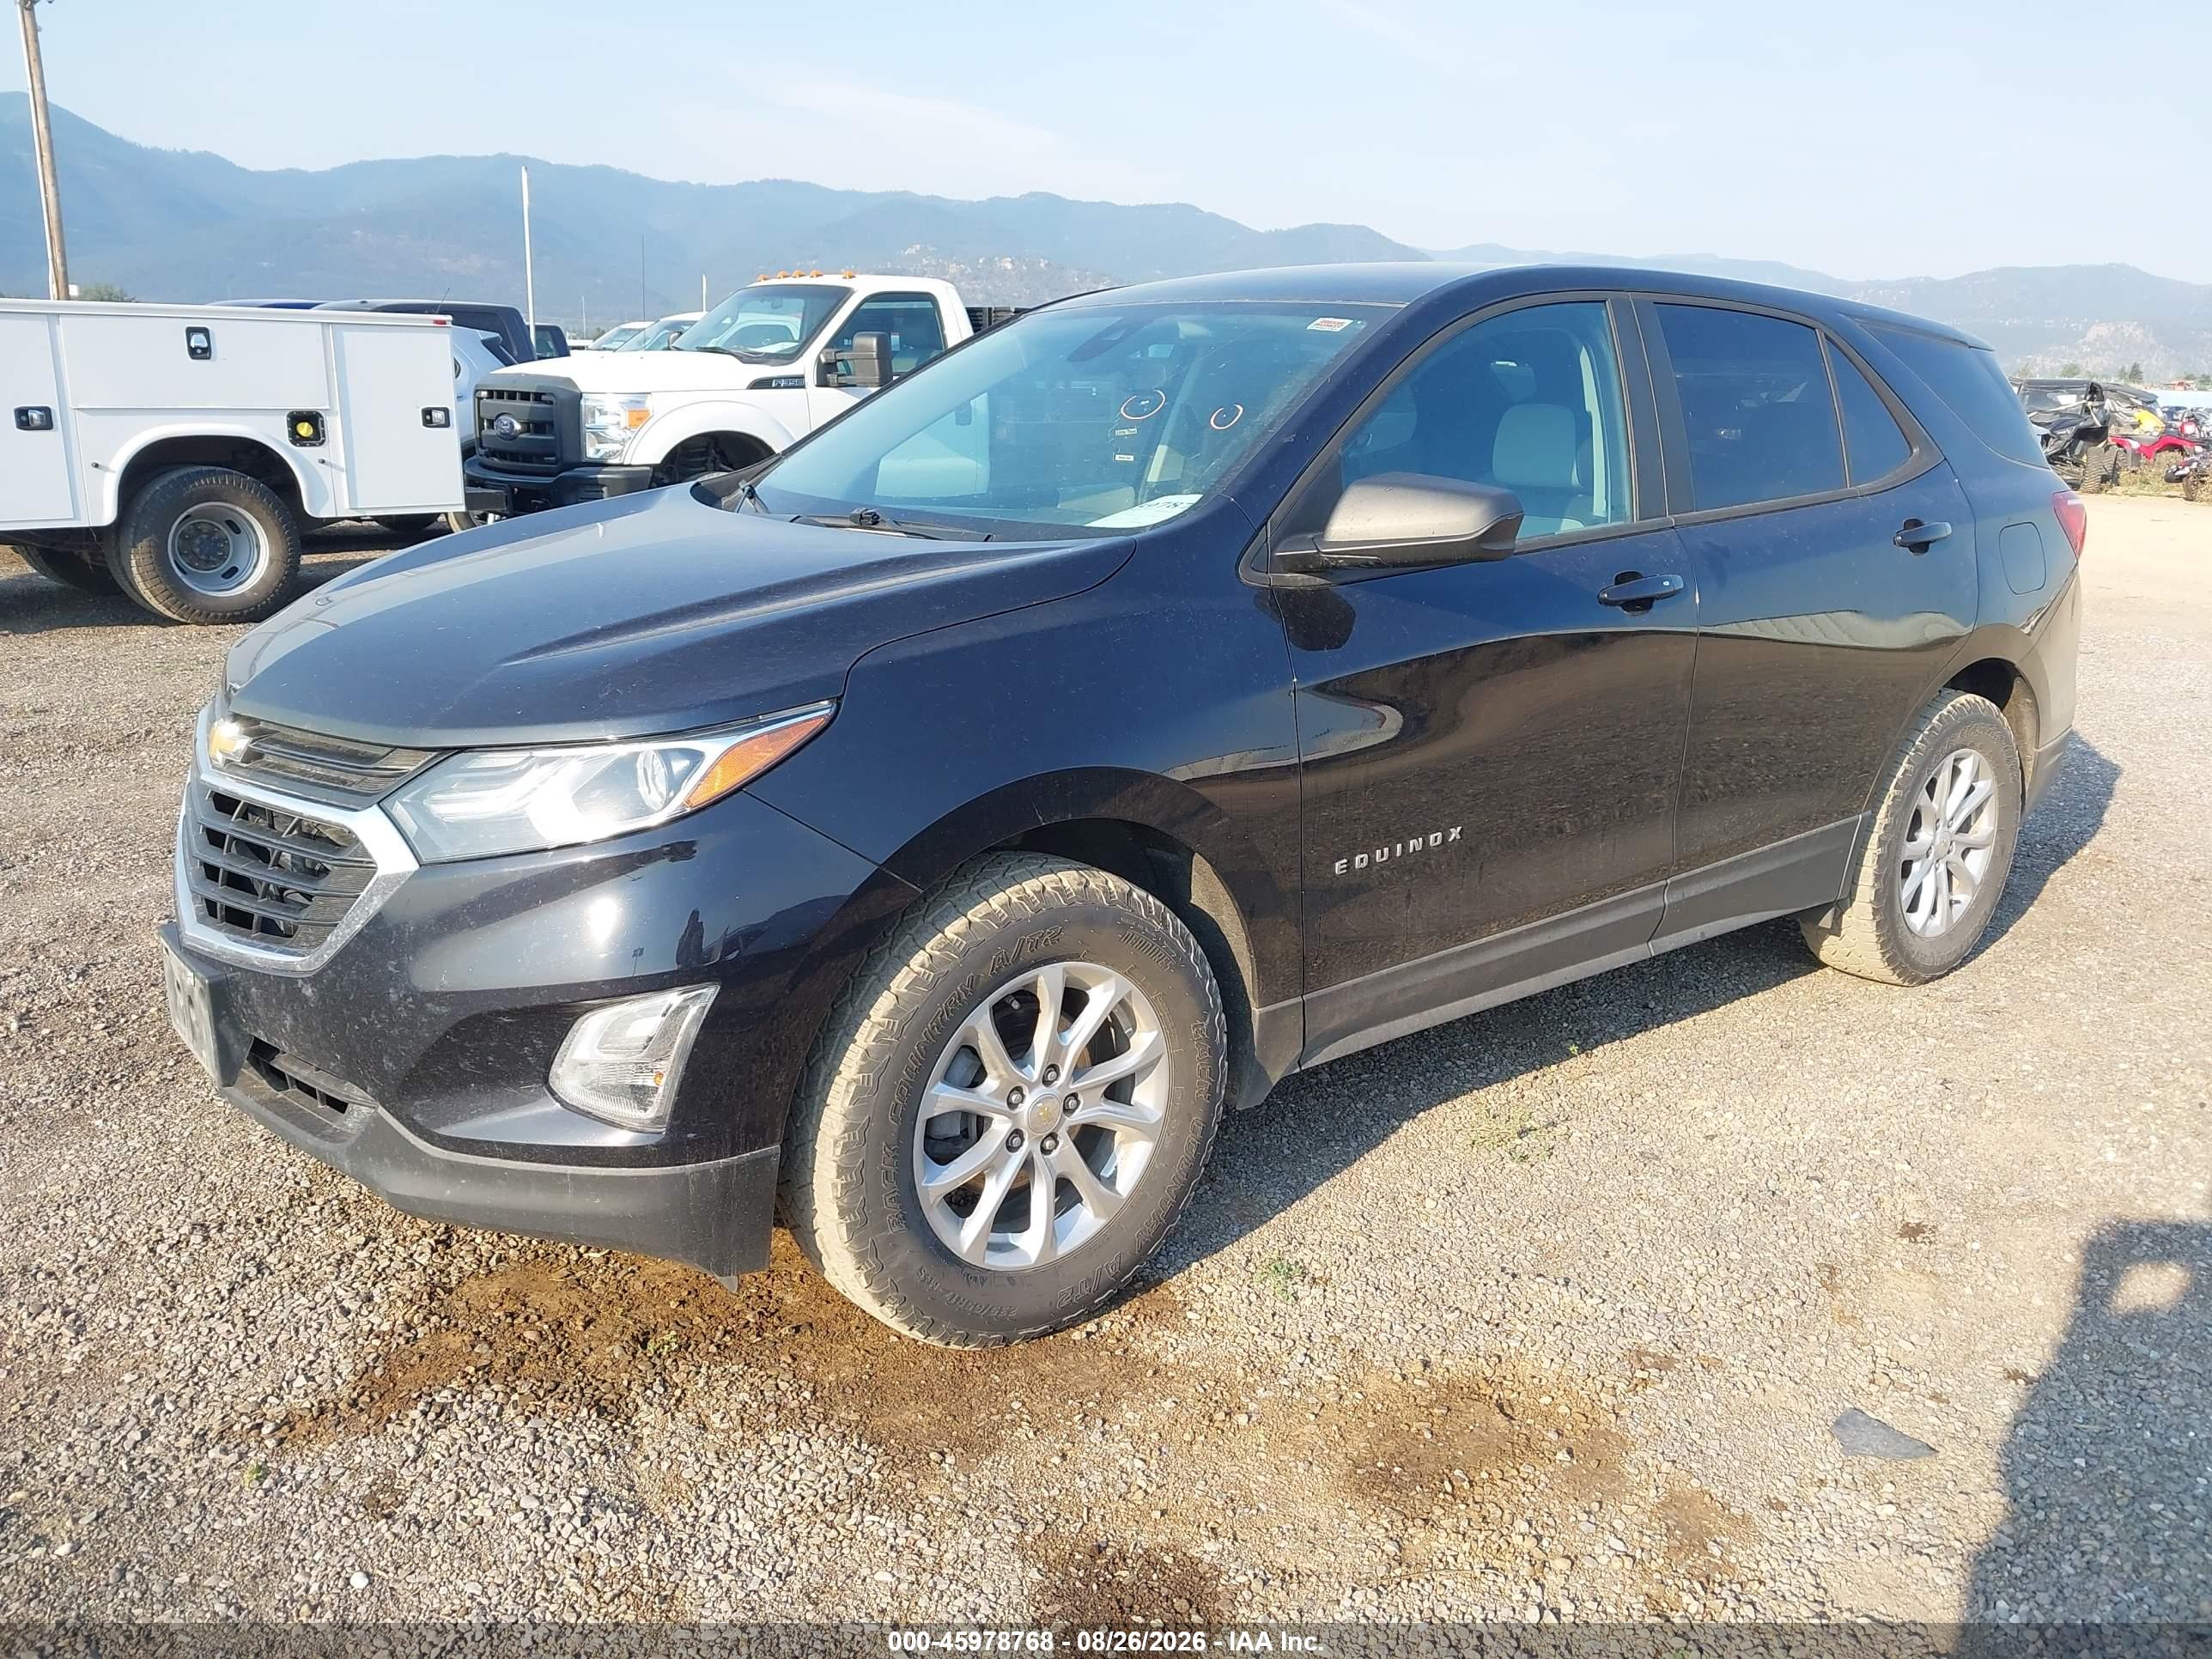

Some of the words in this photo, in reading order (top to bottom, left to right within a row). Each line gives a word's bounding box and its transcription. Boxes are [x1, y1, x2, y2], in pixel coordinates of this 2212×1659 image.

[1334, 826, 1463, 875] EQUINOX
[888, 971, 976, 1126] COUNTRY
[881, 1140, 908, 1234] BACK
